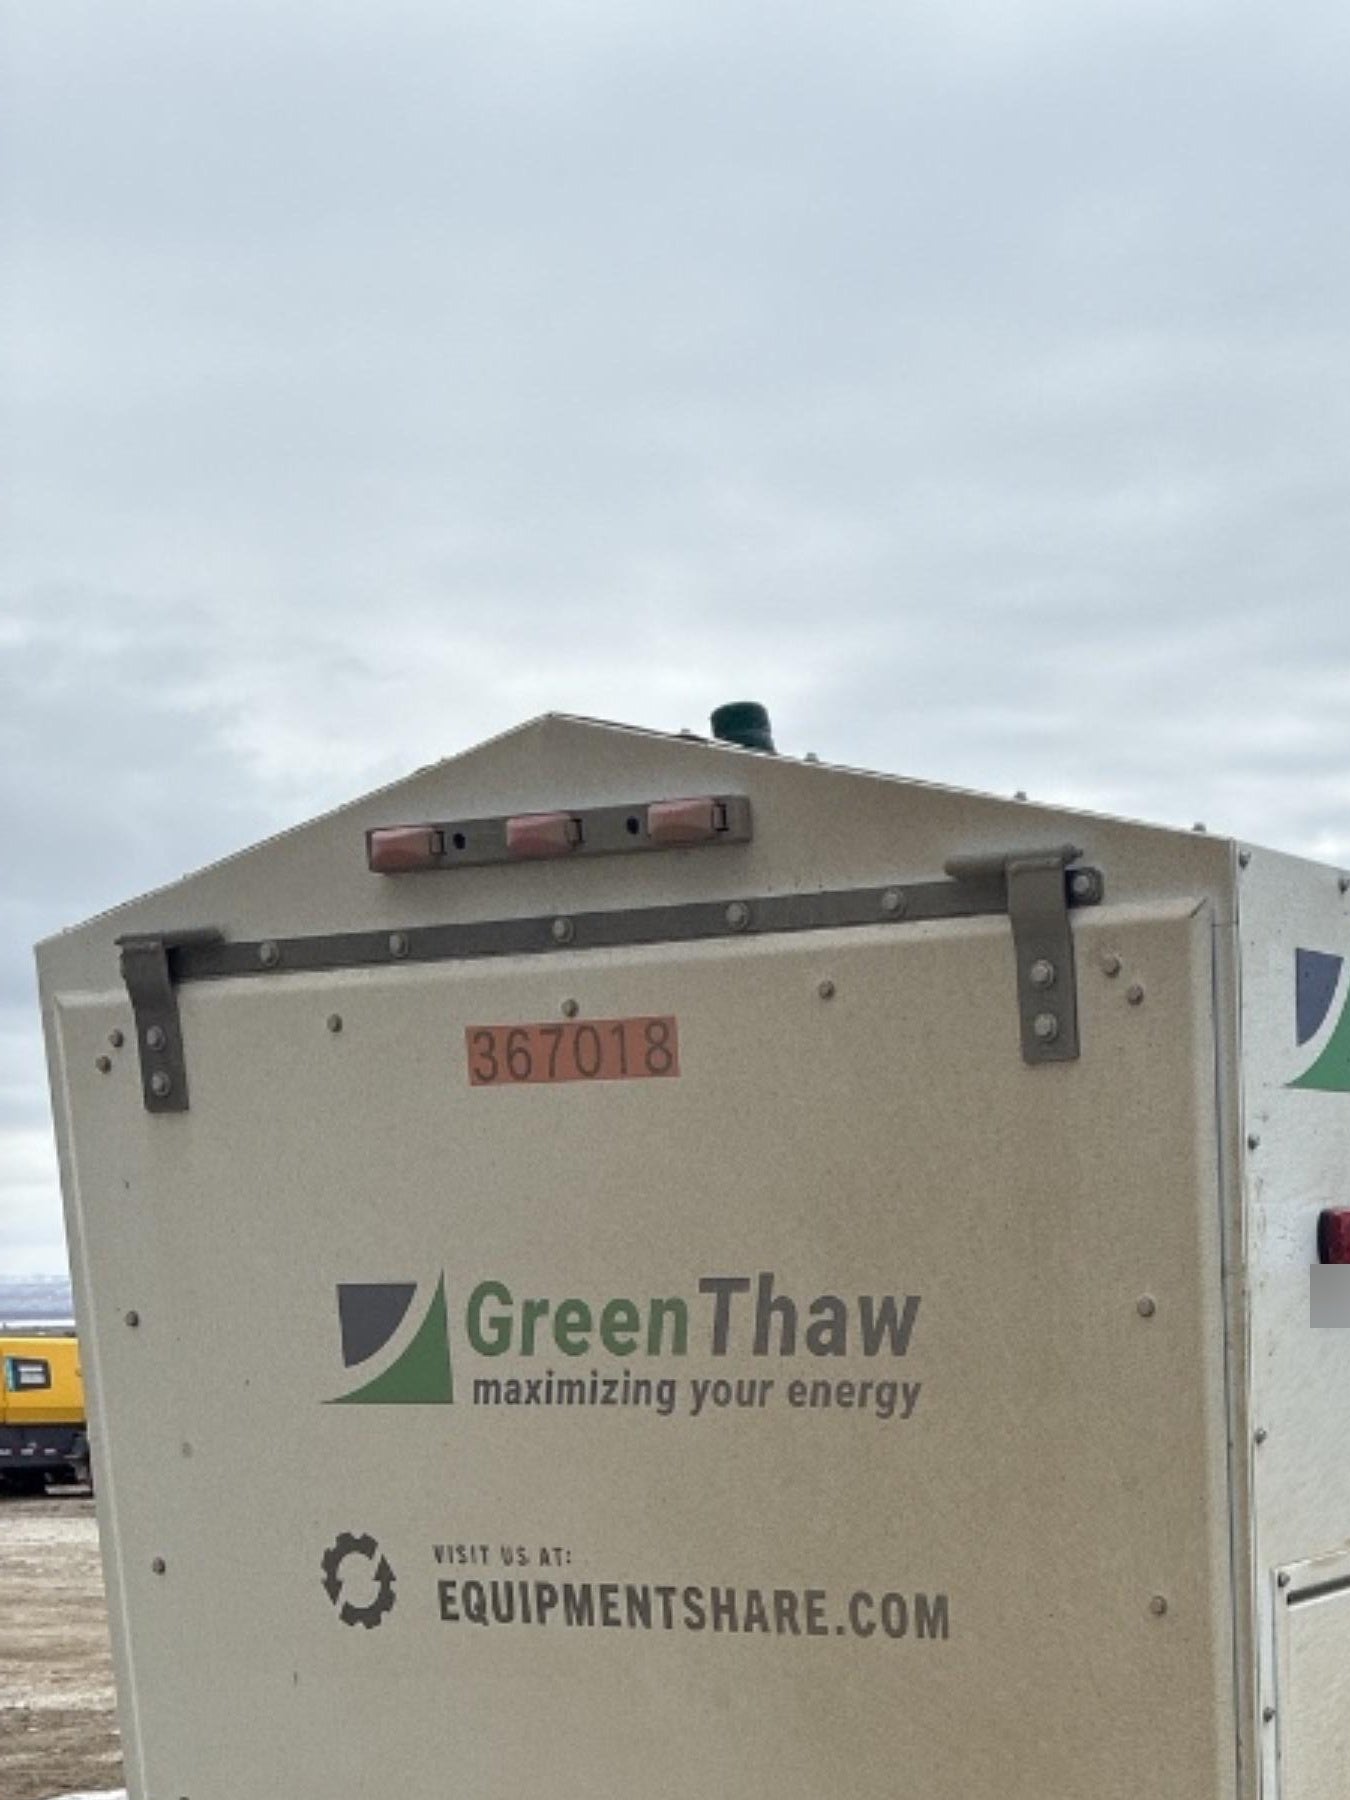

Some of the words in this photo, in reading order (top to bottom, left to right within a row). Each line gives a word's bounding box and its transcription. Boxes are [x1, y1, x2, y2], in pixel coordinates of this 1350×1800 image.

[473, 1020, 673, 1082] 367018
[466, 1272, 921, 1357] GreenThaw
[473, 1369, 677, 1416] maximizing
[690, 1377, 774, 1416] your
[788, 1379, 922, 1420] energy
[432, 1544, 490, 1565] VISIT
[502, 1546, 530, 1566] US
[540, 1547, 572, 1567] AT:
[437, 1579, 950, 1639] EQUIPMENTSHARE.COM
